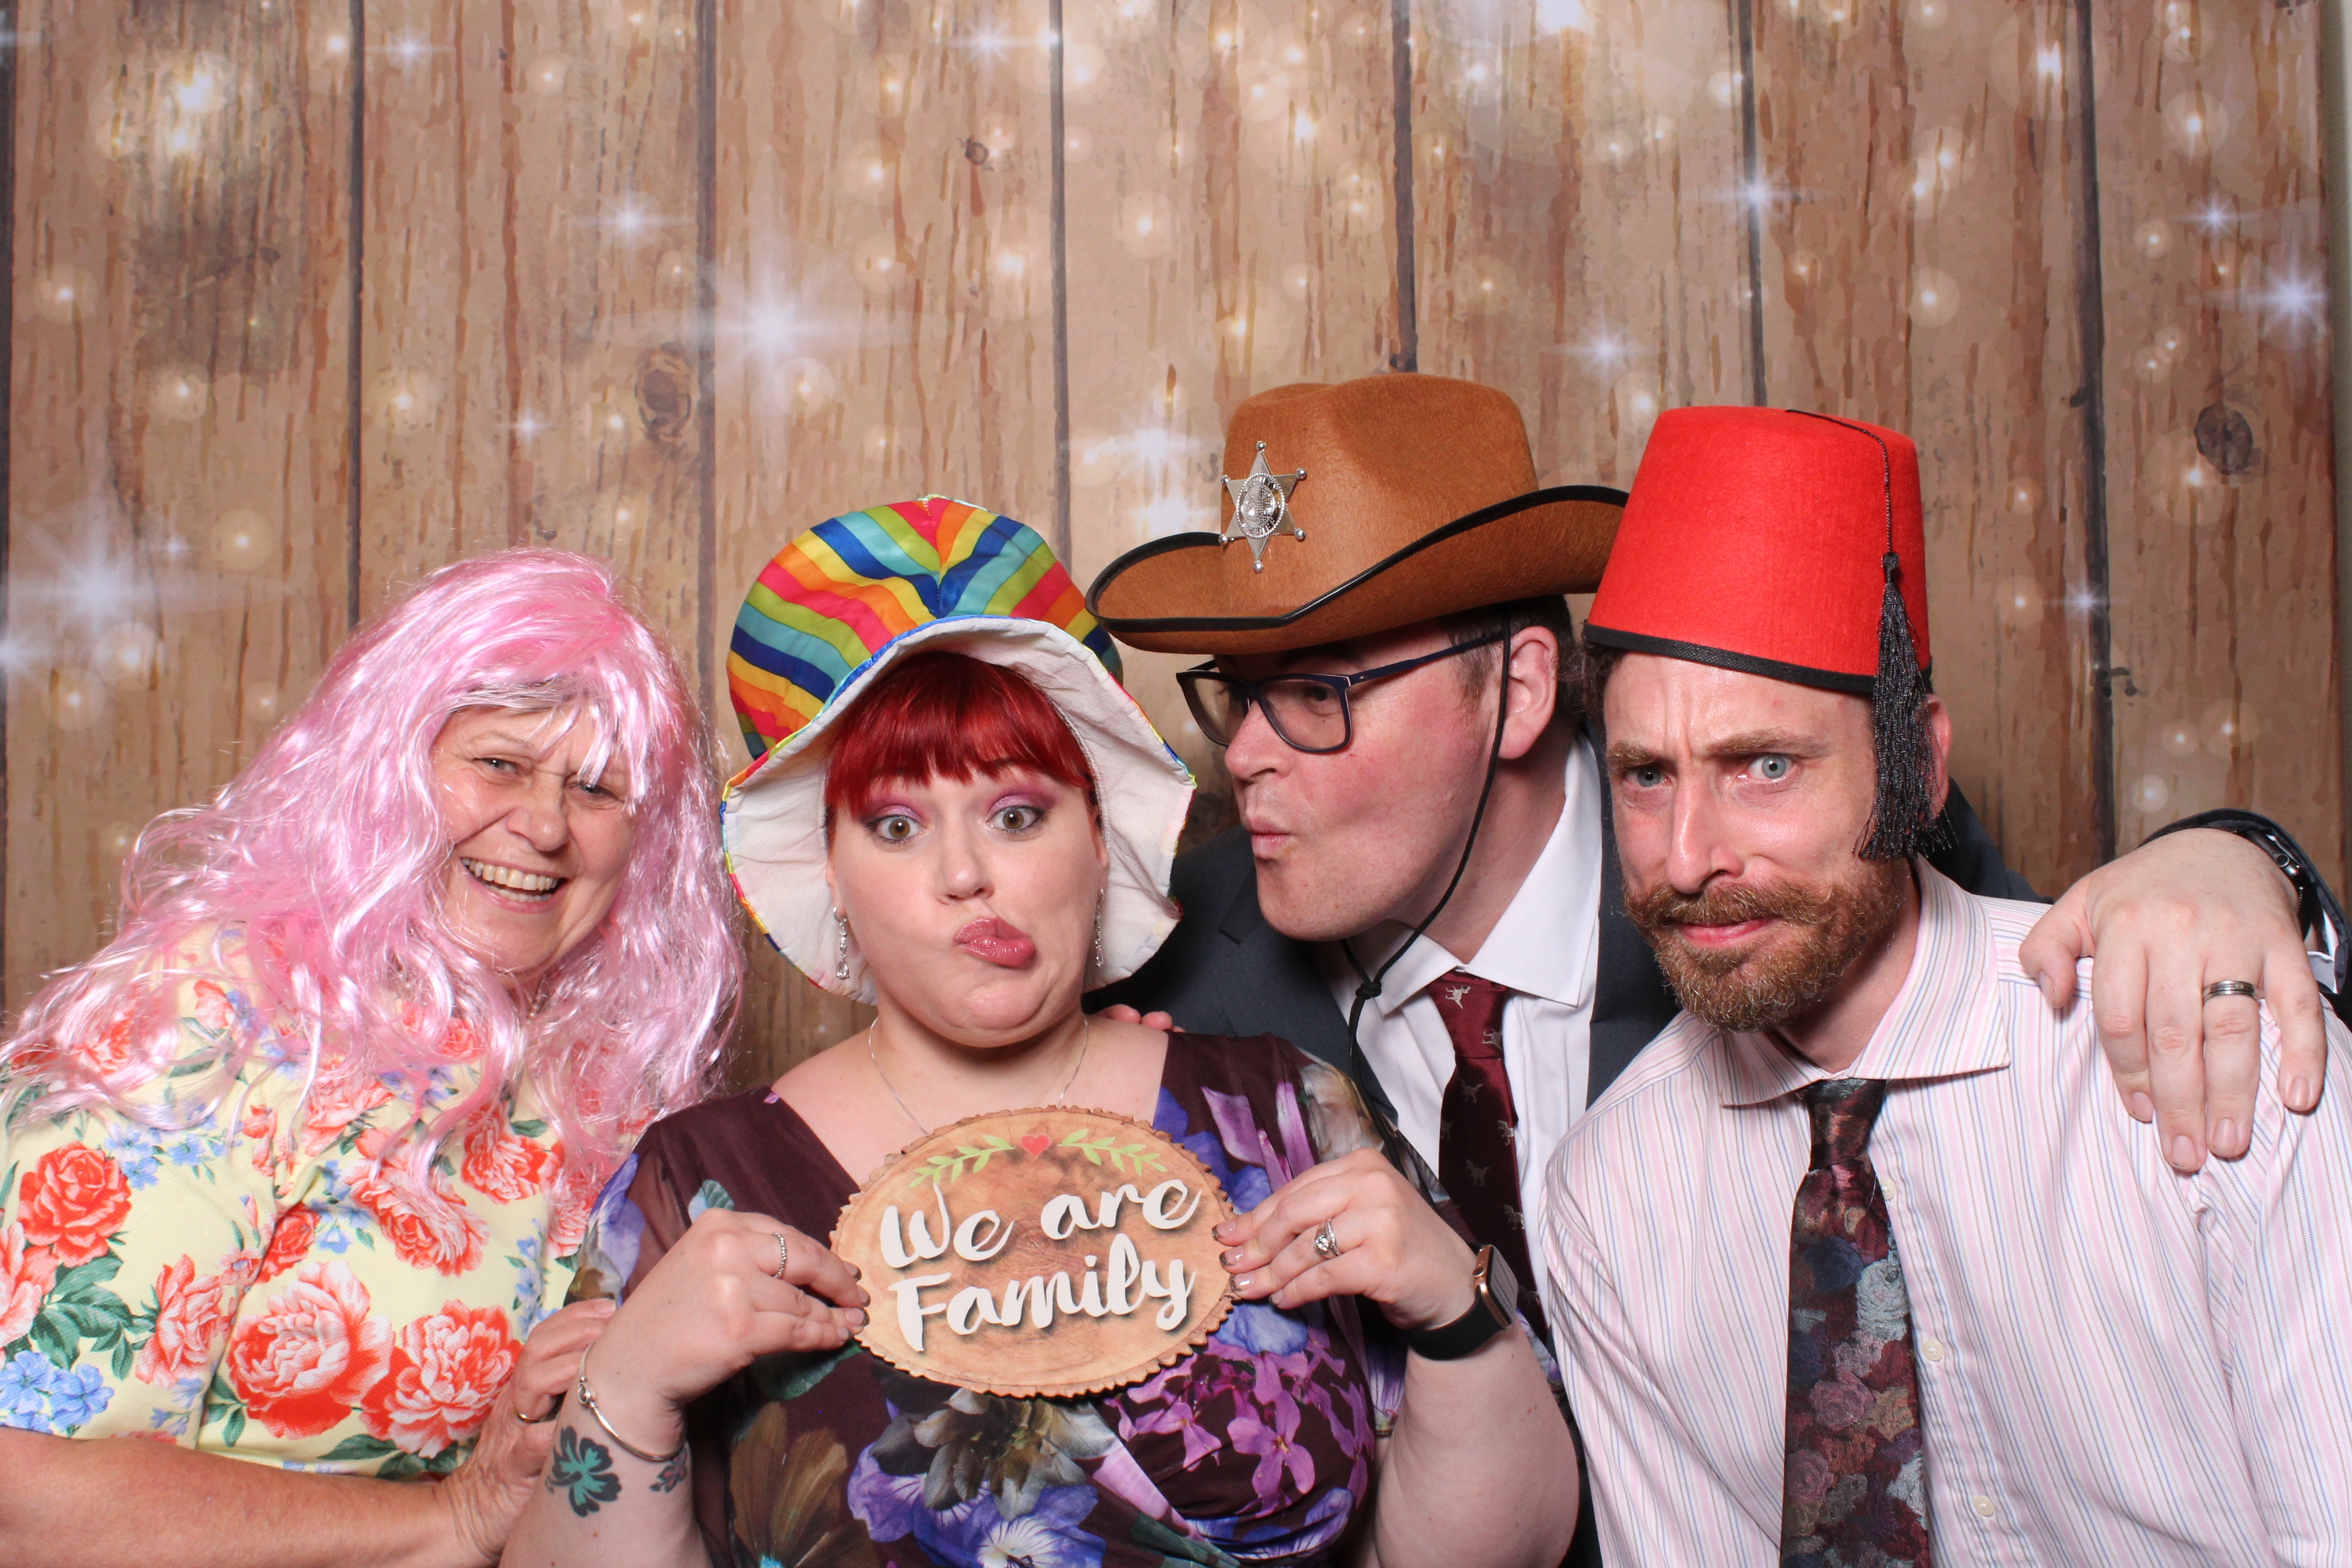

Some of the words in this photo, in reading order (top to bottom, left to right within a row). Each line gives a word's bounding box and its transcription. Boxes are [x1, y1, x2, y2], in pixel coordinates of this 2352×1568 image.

[880, 1183, 1015, 1269] We
[1040, 1179, 1202, 1241] are
[887, 1233, 1196, 1352] Family
